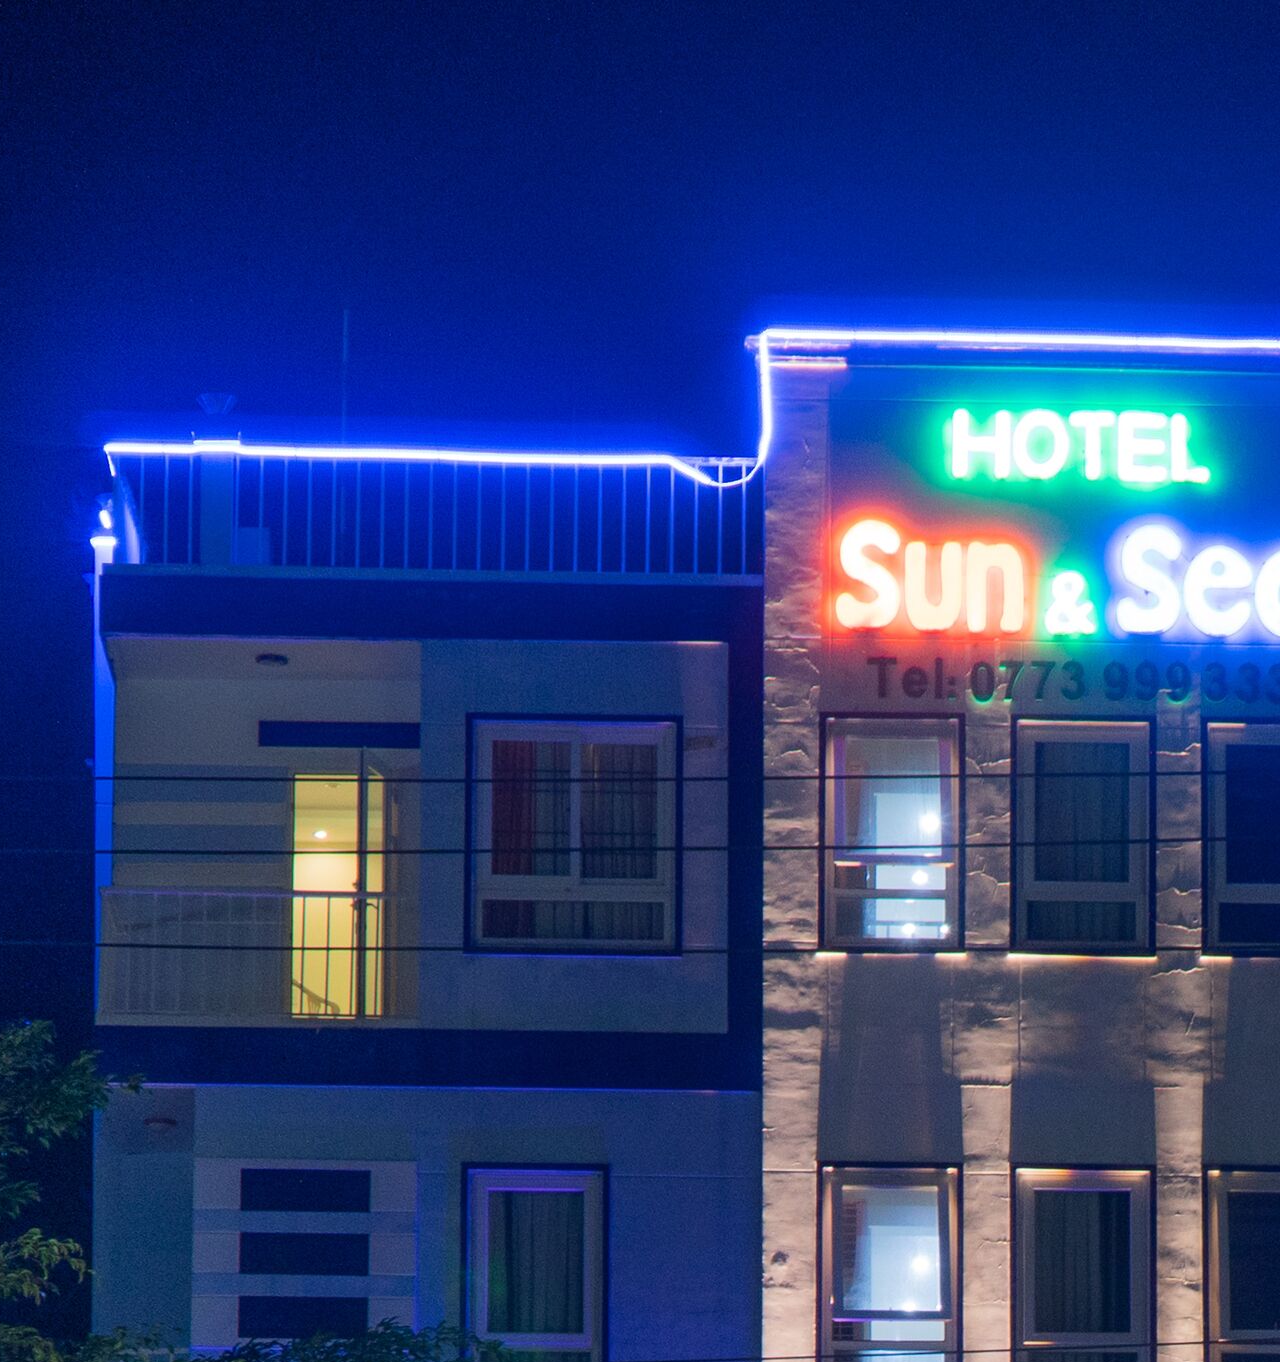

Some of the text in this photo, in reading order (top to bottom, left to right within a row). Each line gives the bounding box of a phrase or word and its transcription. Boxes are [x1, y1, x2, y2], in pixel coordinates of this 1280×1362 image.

[950, 407, 1211, 484] HOTEL
[835, 519, 1023, 632] Sun
[1044, 571, 1097, 635] &
[867, 656, 956, 700] Tel:
[971, 660, 1086, 703] 0773
